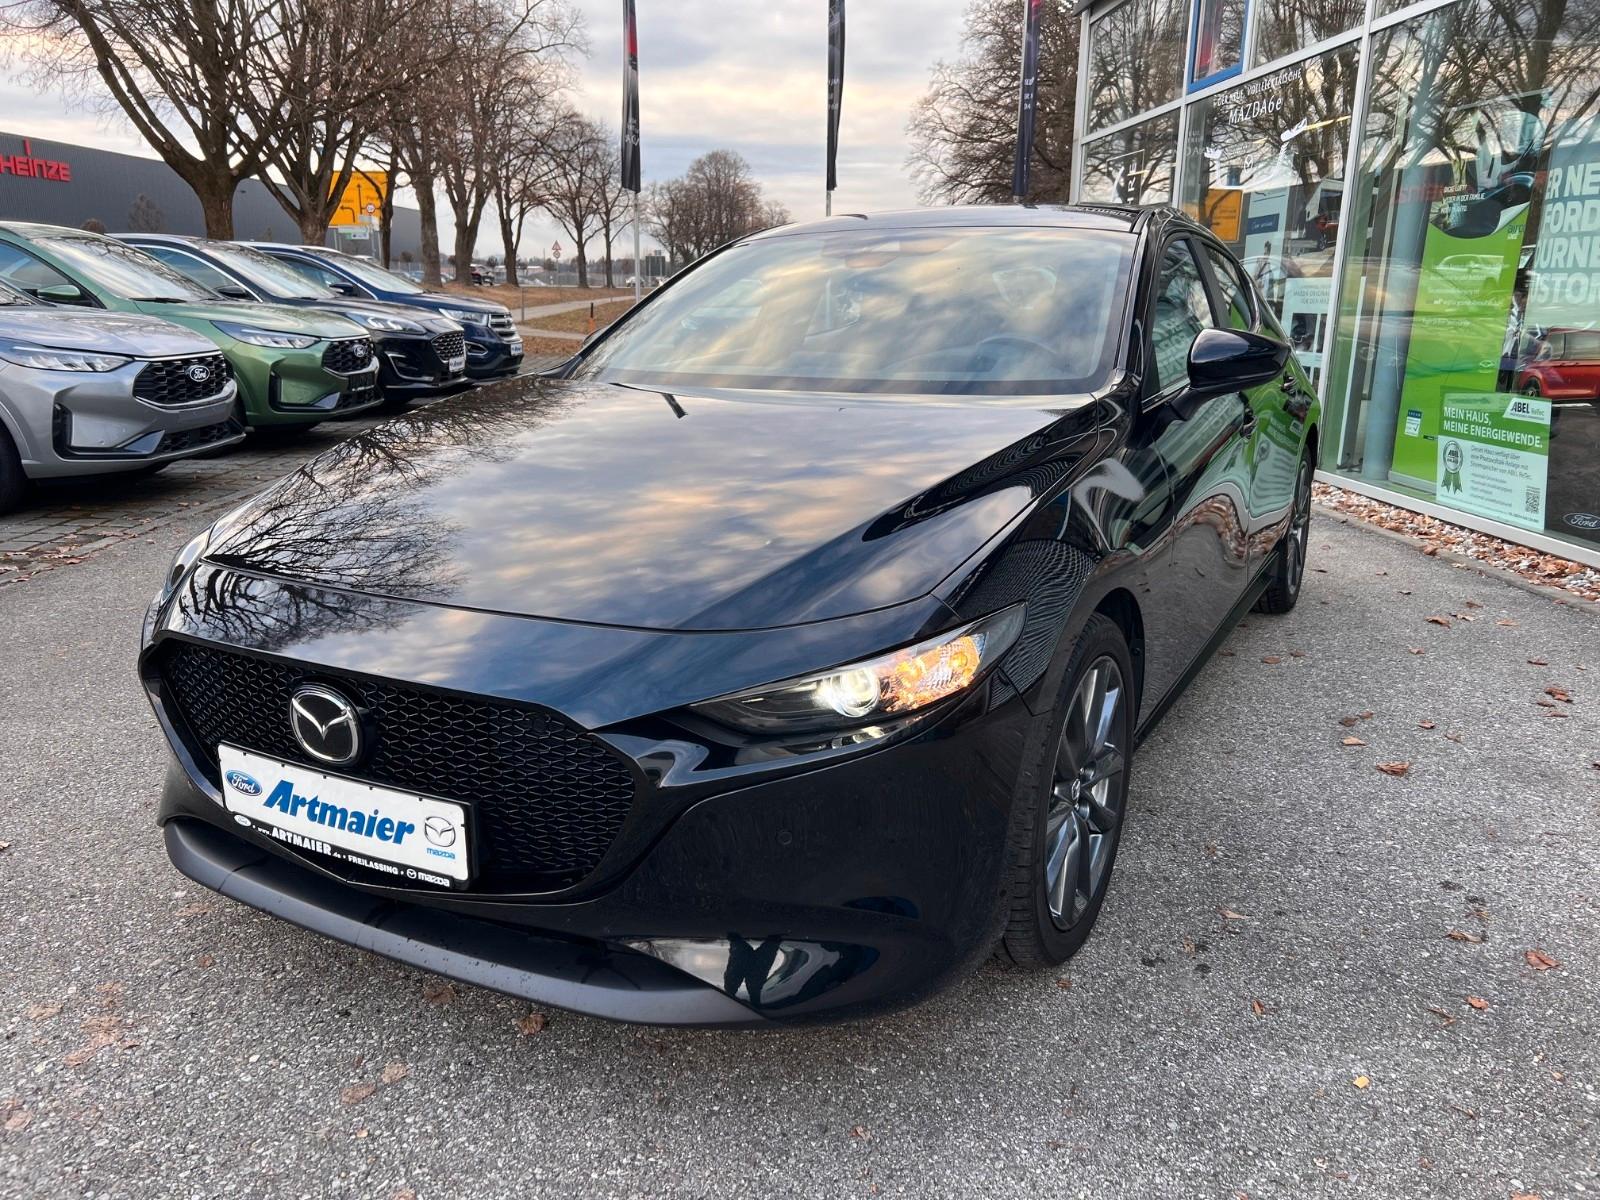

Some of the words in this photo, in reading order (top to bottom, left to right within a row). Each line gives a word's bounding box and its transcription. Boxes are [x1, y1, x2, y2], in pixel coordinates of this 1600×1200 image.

[1229, 95, 1282, 125] MAZDA6e
[1542, 198, 1600, 234] FORD
[1443, 406, 1466, 420] MEIN
[1466, 410, 1492, 426] HAUS,
[1511, 402, 1530, 414] ABEL
[1443, 420, 1469, 434] MEINE
[1470, 426, 1543, 448] ENERGIEWENDE.
[1570, 514, 1598, 527] Ford
[231, 773, 256, 793] Ford
[263, 779, 415, 845] Artmaier
[426, 847, 456, 860] mazda
[347, 854, 399, 875] FREILASSING
[418, 872, 451, 888] mazda
